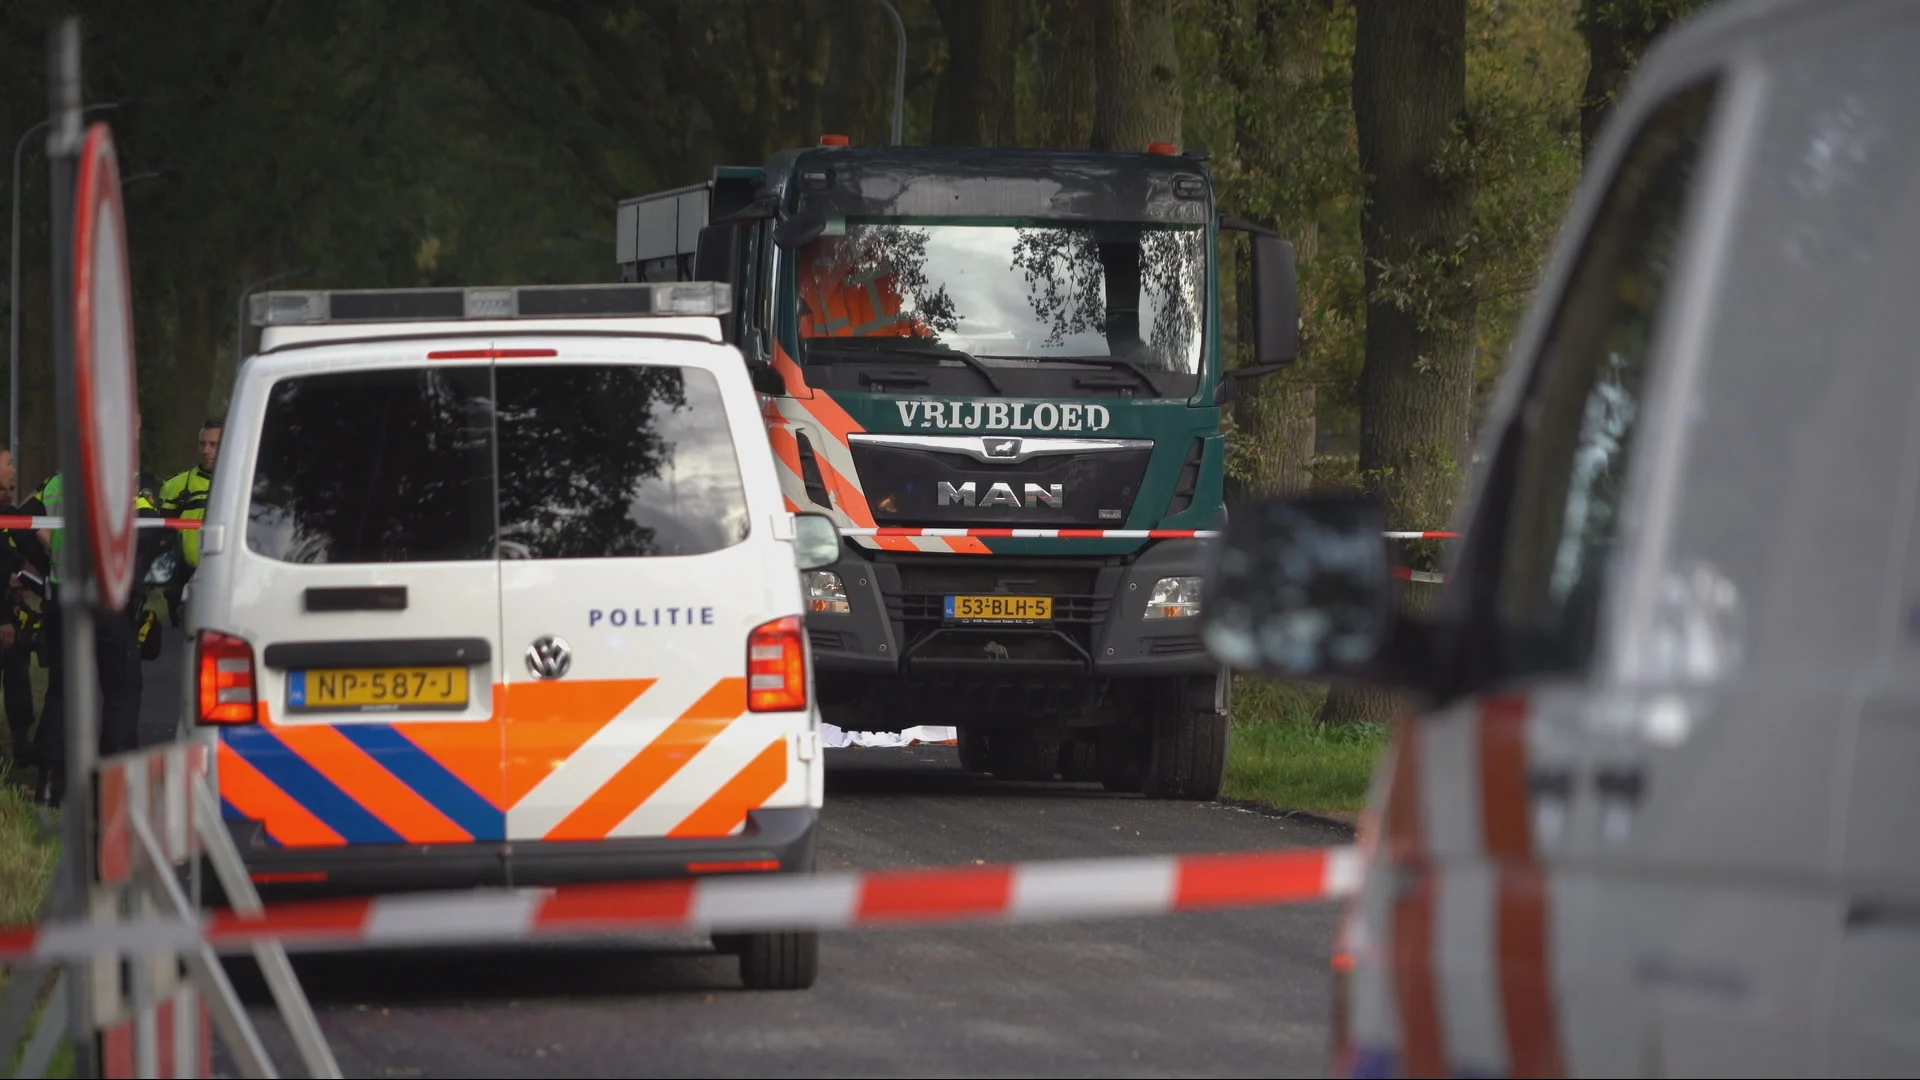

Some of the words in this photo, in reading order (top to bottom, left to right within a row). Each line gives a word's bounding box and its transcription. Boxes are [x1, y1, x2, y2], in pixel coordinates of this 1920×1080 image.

[896, 400, 1110, 431] VRIJBLOED
[937, 481, 1063, 508] MAN
[589, 606, 714, 627] POLITIE
[962, 599, 1046, 616] 53-BLH-5
[318, 672, 453, 700] NP-587-J
